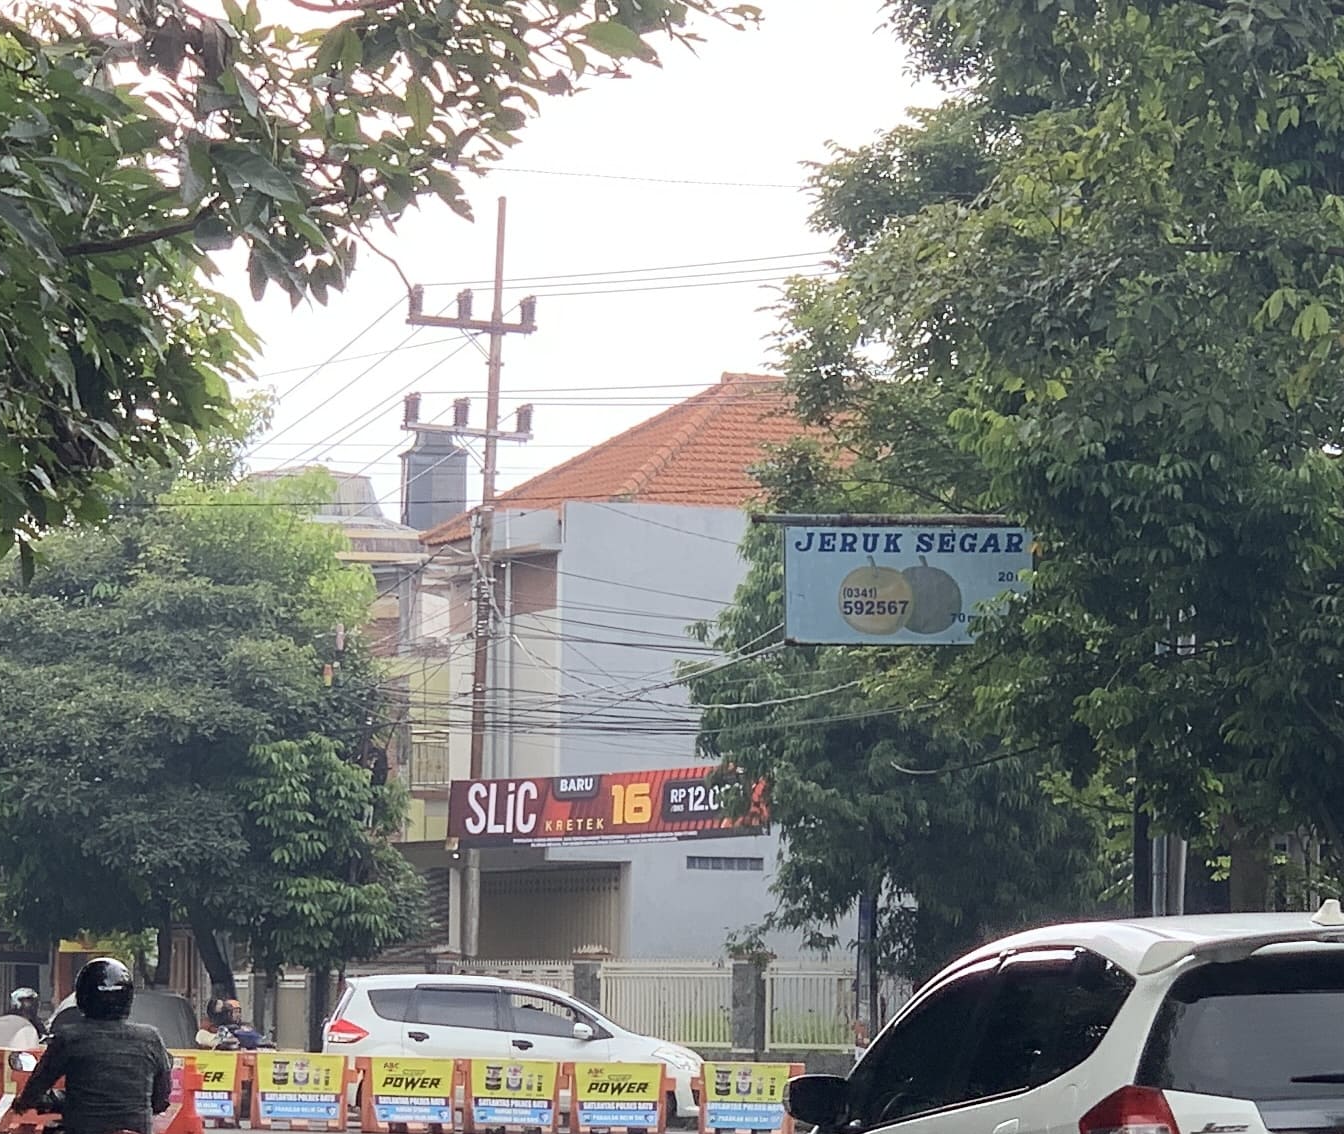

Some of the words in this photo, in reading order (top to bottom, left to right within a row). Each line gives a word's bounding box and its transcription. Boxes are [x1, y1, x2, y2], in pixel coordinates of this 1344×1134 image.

[794, 532, 903, 553] JERUK
[915, 532, 1024, 553] SEGAR
[842, 587, 877, 600] (0341)
[843, 601, 909, 616] 592567
[559, 777, 594, 794] BARU
[670, 788, 687, 803] RP
[611, 782, 651, 826] 16
[545, 817, 604, 832] KRETEK
[382, 1077, 442, 1091] POWER
[587, 1082, 649, 1096] POWER
